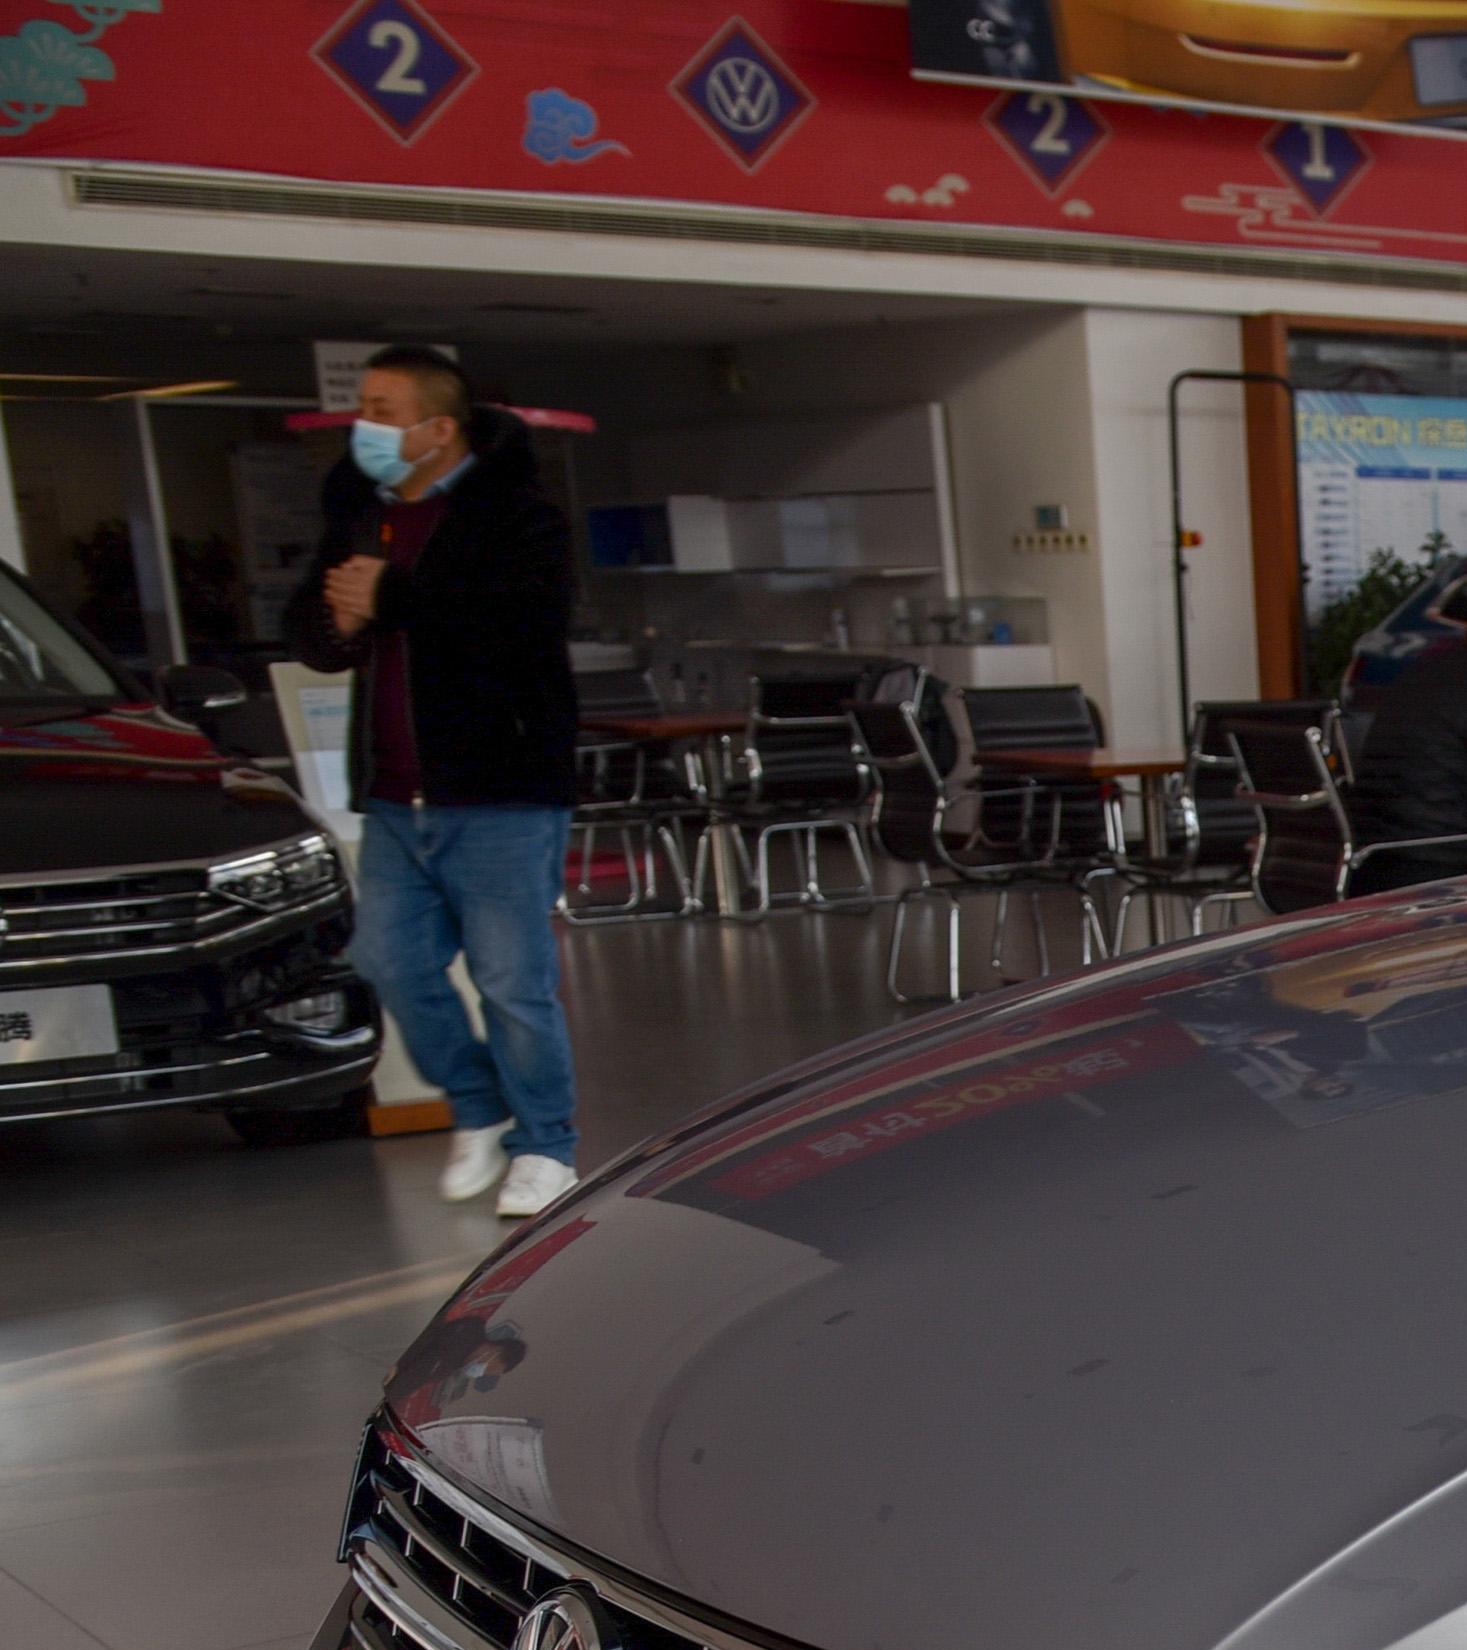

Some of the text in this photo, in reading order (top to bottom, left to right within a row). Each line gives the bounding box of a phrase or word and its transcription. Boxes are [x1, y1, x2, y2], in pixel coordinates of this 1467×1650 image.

[368, 20, 426, 95] 2
[1028, 94, 1070, 154] 2
[1303, 125, 1335, 181] 1
